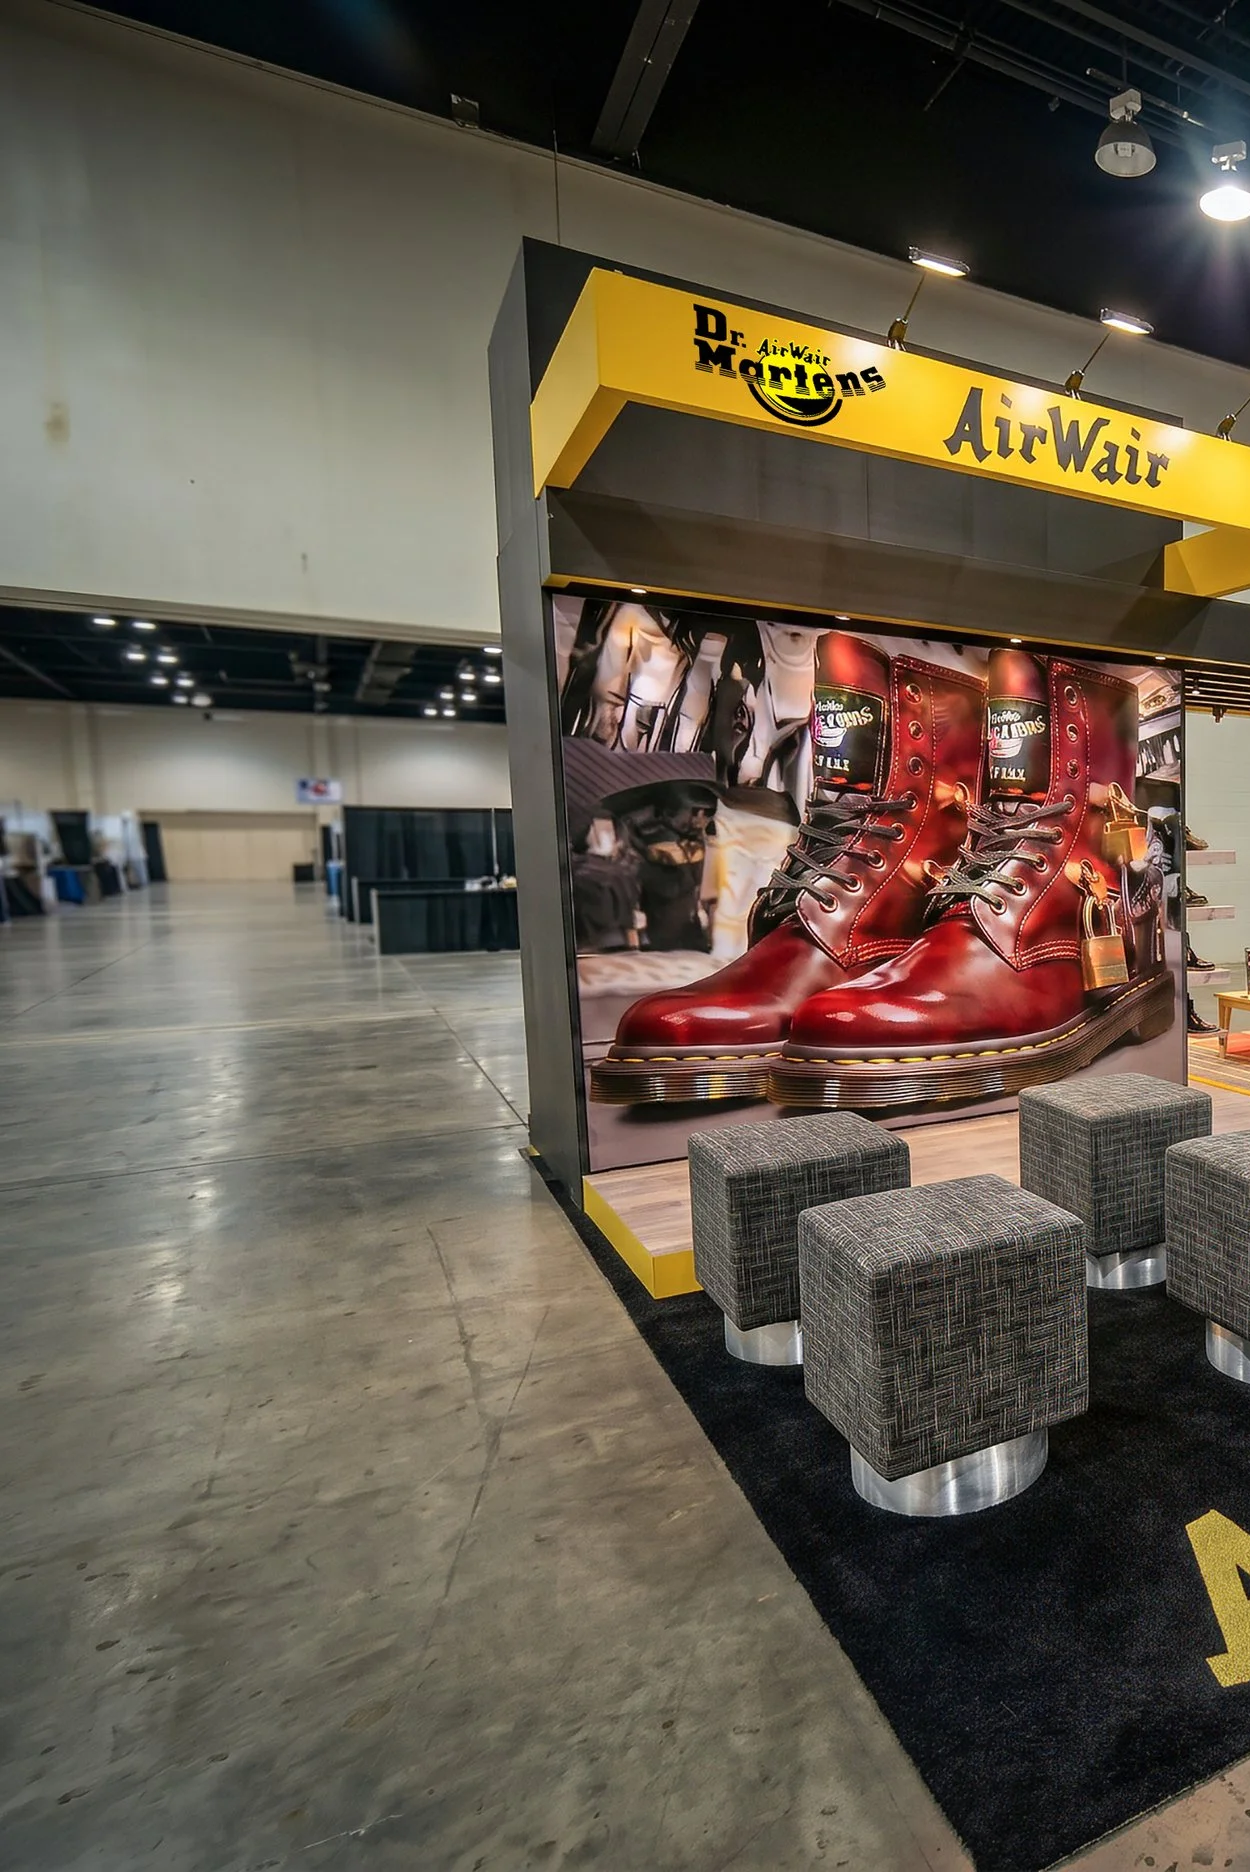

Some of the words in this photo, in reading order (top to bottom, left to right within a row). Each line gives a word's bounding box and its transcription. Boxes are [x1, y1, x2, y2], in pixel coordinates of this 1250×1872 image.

[693, 303, 747, 348] Dr.
[693, 338, 887, 398] Martens
[756, 338, 831, 367] AirWair
[943, 386, 1170, 489] AirWair
